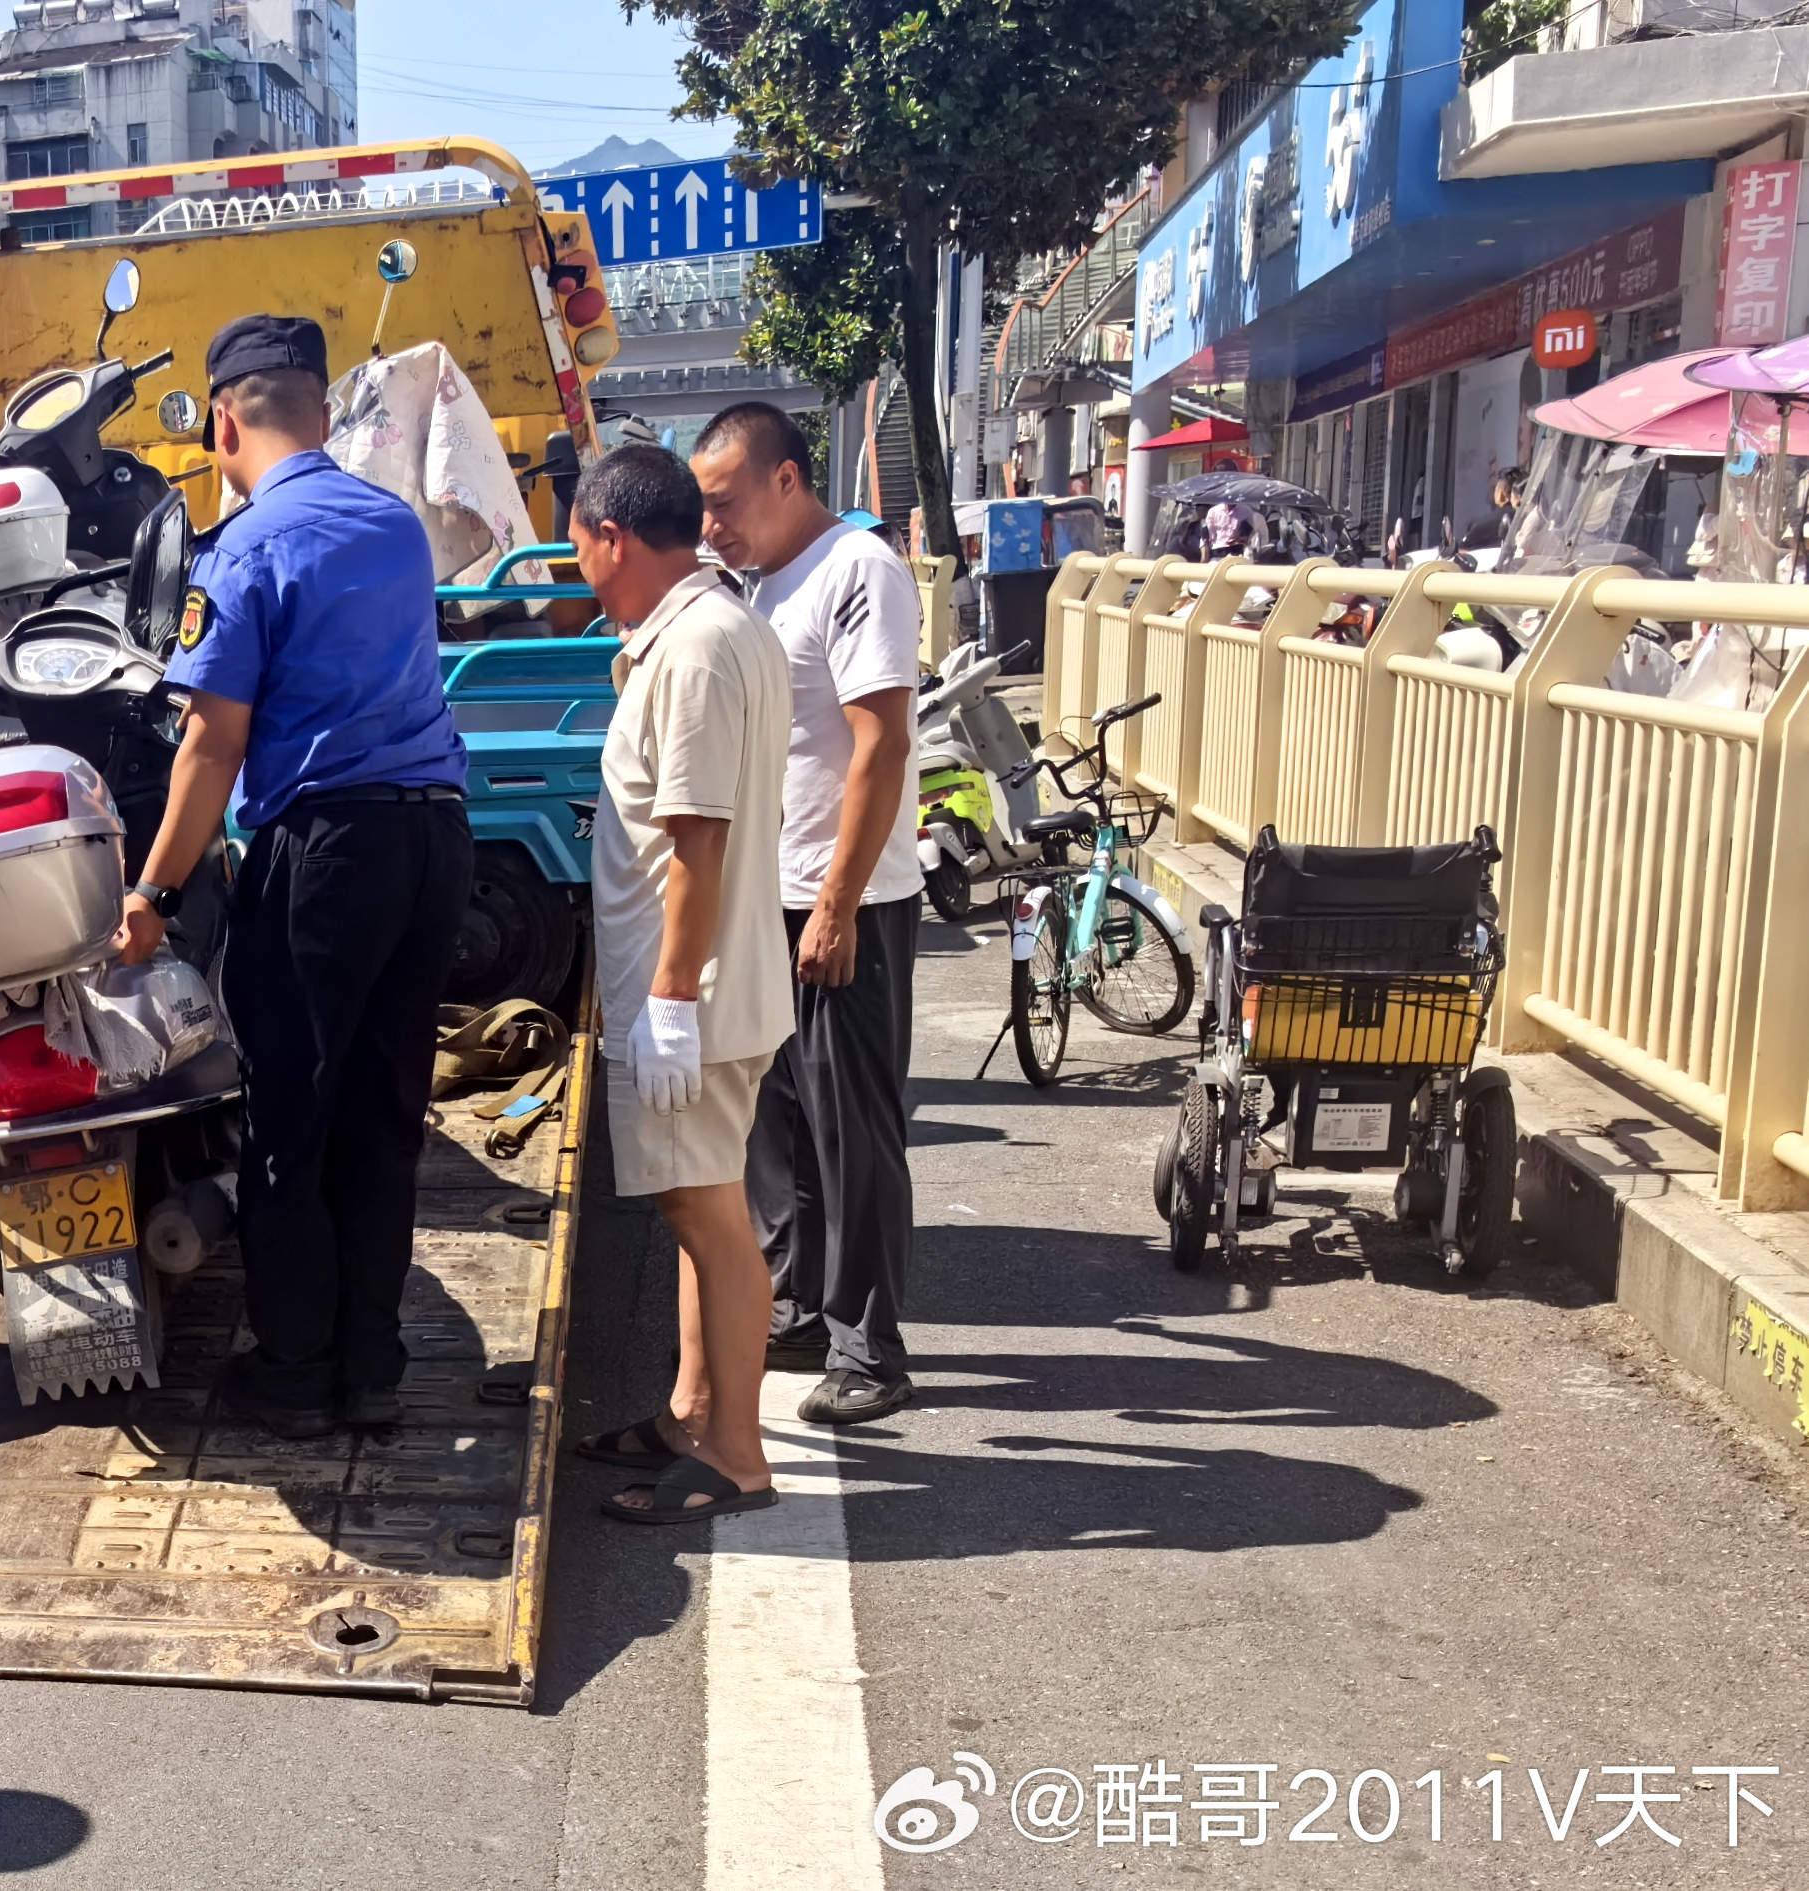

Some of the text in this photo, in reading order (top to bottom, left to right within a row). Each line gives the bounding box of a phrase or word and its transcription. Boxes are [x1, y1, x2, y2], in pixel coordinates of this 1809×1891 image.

[1518, 250, 1606, 328] 高优惠500元
[1730, 170, 1791, 337] 打字复印
